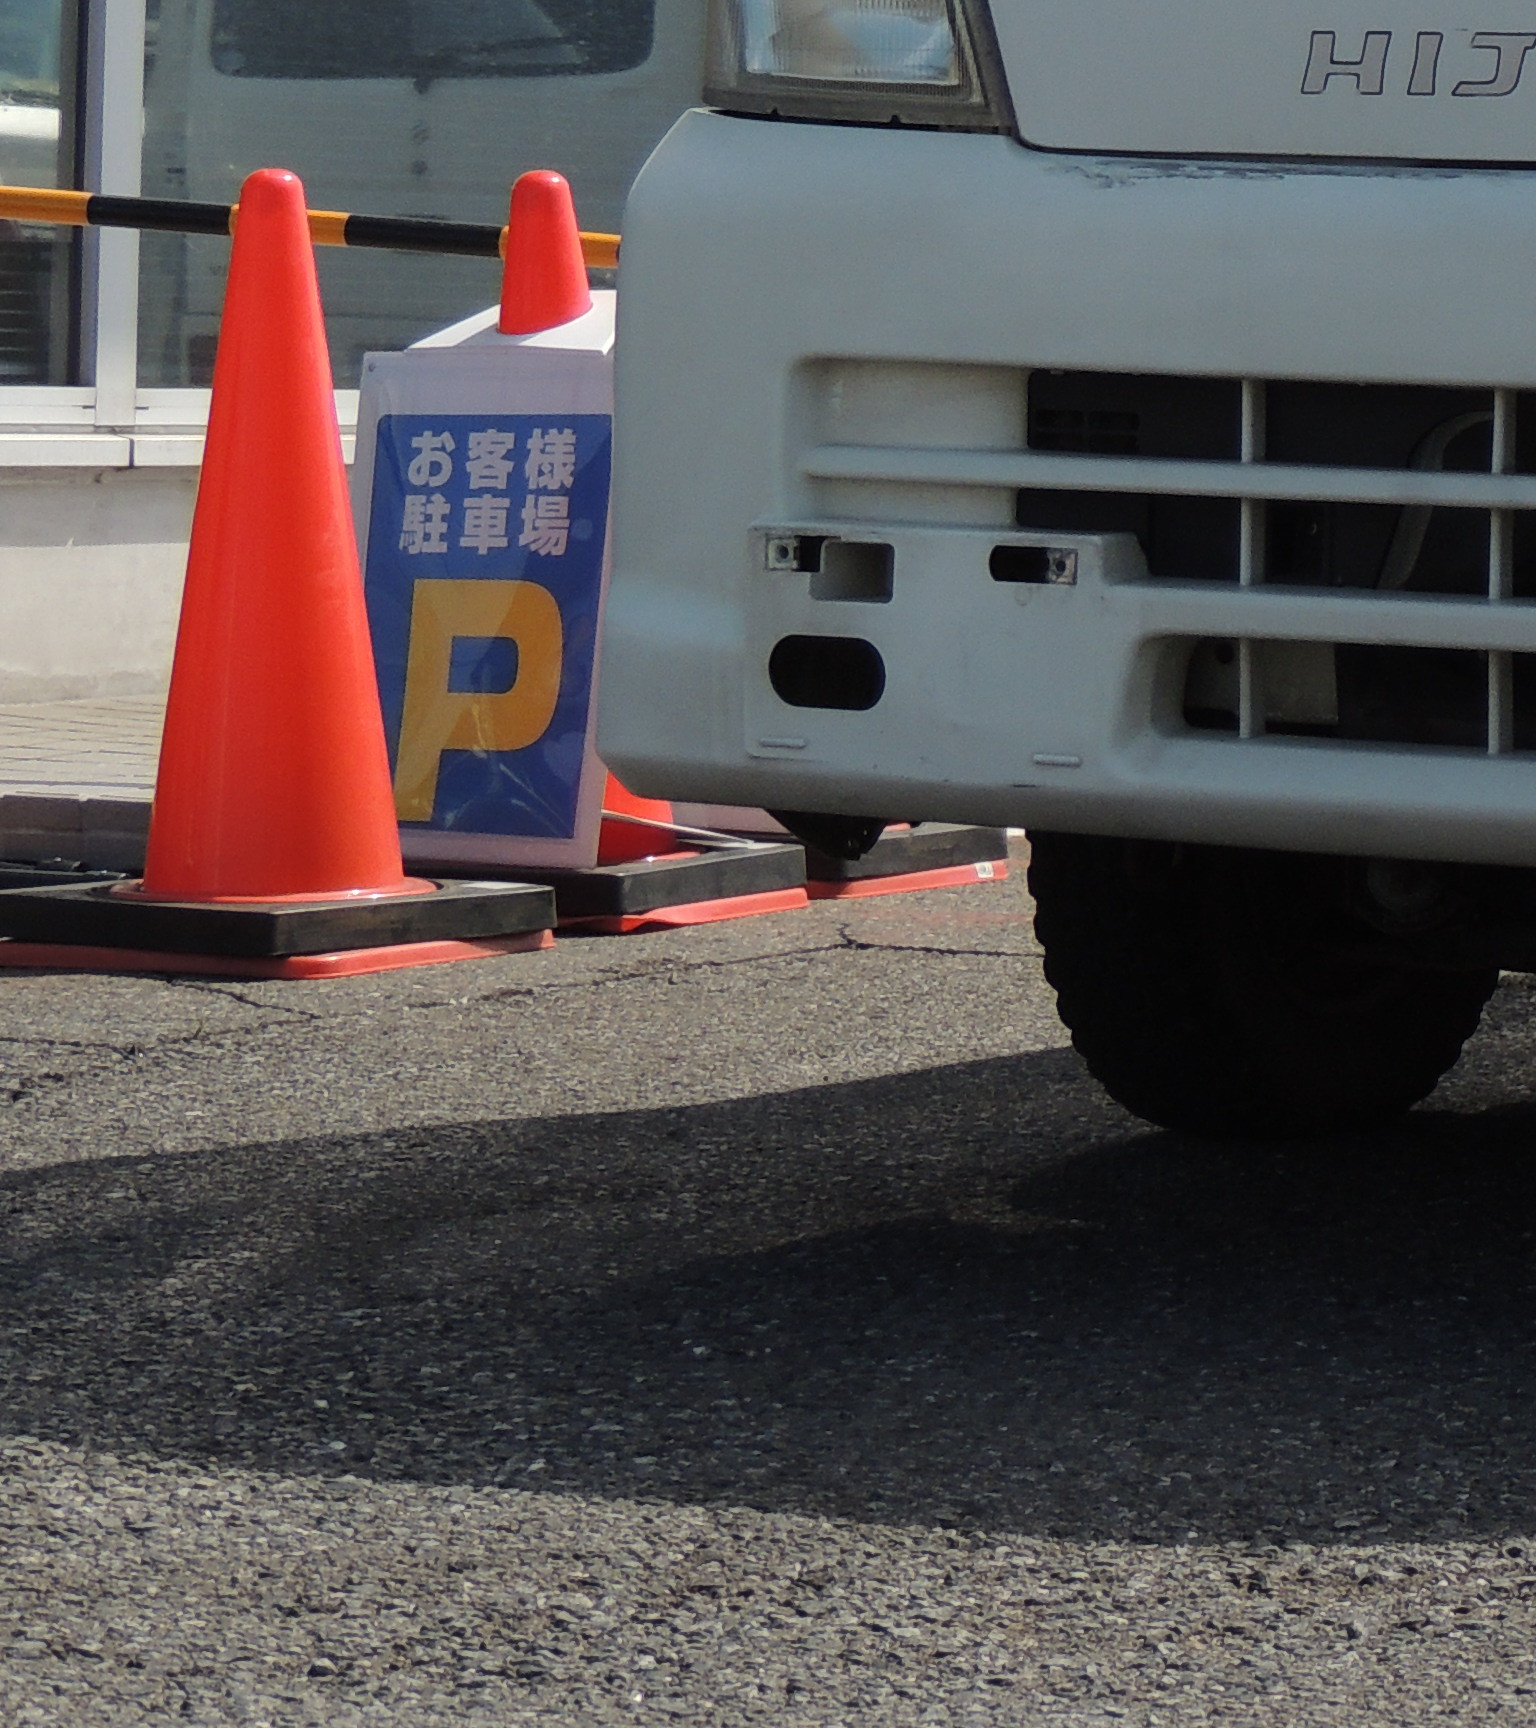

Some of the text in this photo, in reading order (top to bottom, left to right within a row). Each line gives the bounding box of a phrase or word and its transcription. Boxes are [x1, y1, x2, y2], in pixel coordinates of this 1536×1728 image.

[407, 427, 578, 491] お客様
[398, 494, 571, 557] 駐車場
[394, 578, 563, 822] P
